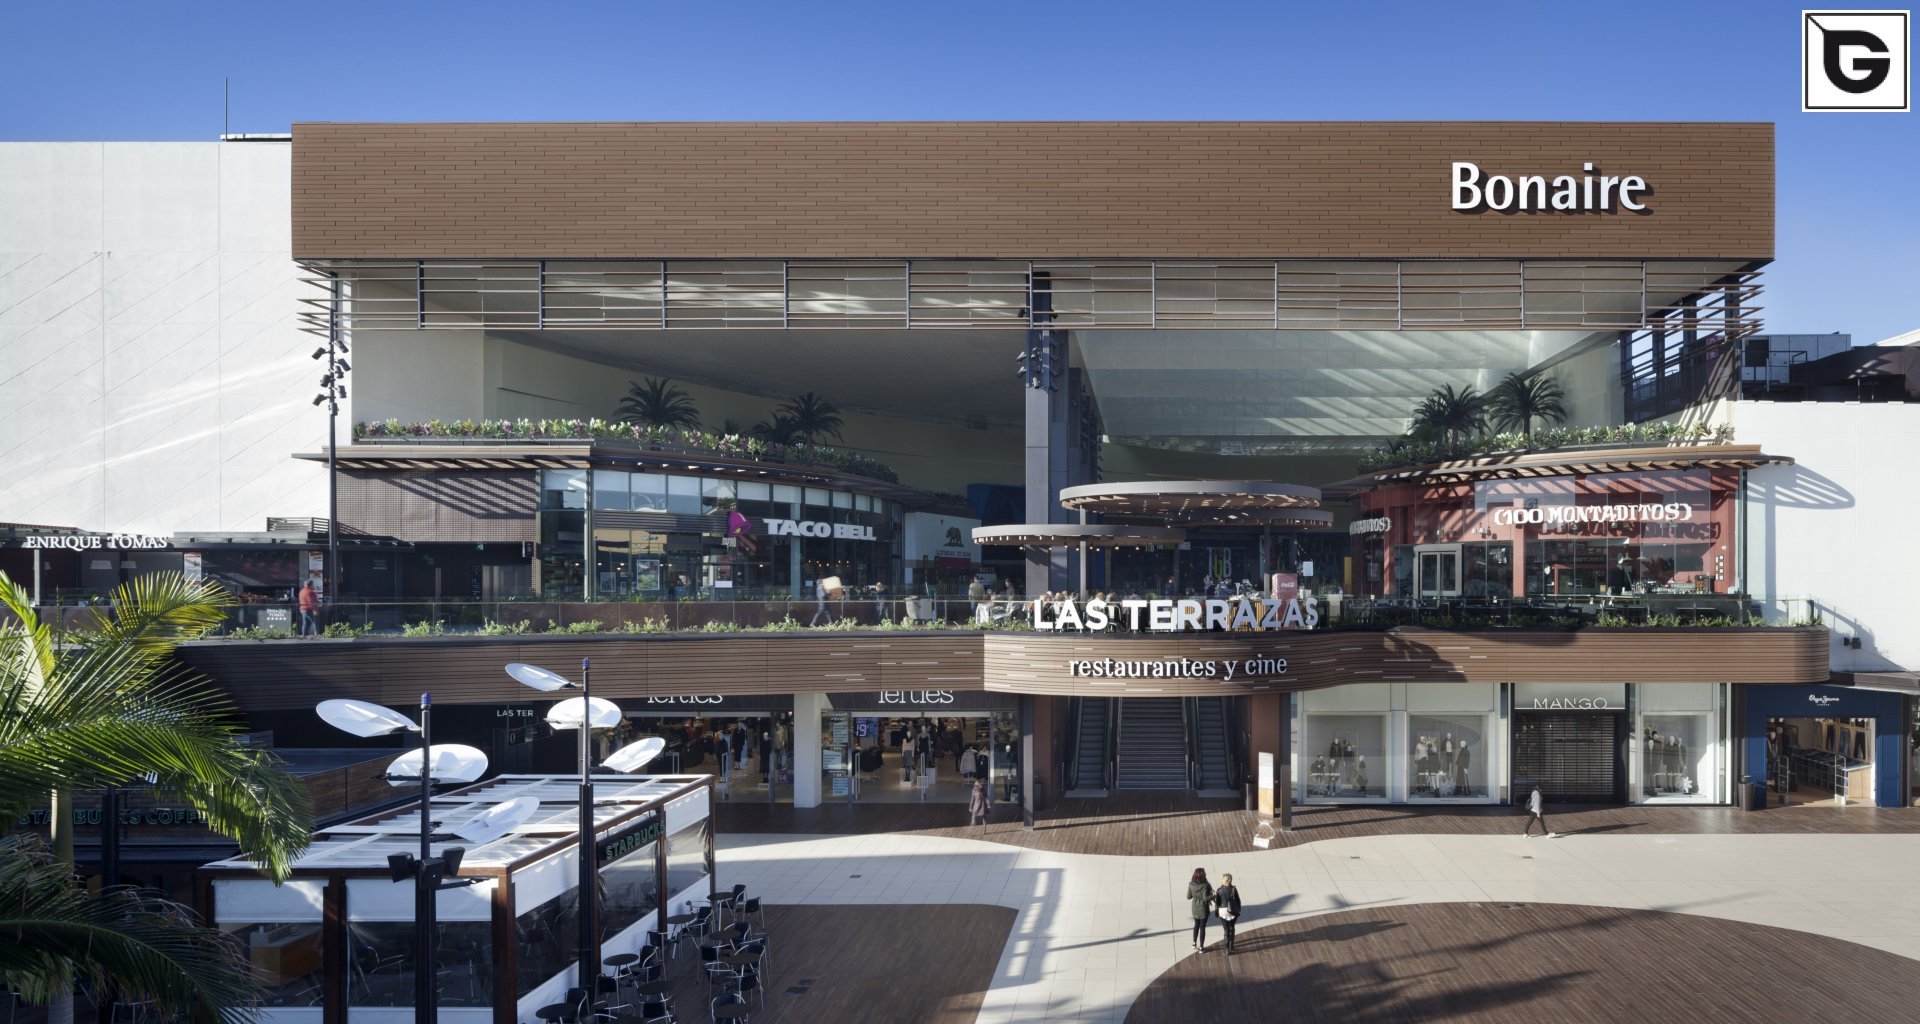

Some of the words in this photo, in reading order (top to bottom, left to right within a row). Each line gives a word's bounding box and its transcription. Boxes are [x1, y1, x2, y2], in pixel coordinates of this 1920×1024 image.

[1452, 162, 1646, 210] Bonaire
[1494, 508, 1544, 525] (100
[1547, 503, 1693, 524] MONTADITOS)
[762, 518, 832, 538] TACO
[833, 523, 877, 541] BELL
[25, 535, 102, 551] ENRIQUE
[1206, 546, 1232, 579] TGB
[1034, 599, 1109, 631] LAS
[1122, 597, 1319, 630] TERRAZAS
[1069, 657, 1216, 677] restaurantes
[1223, 660, 1239, 681] y
[1245, 653, 1288, 675] cine
[496, 709, 514, 717] LAS
[1534, 697, 1608, 710] MANGO
[605, 820, 665, 861] STARBUCKS
